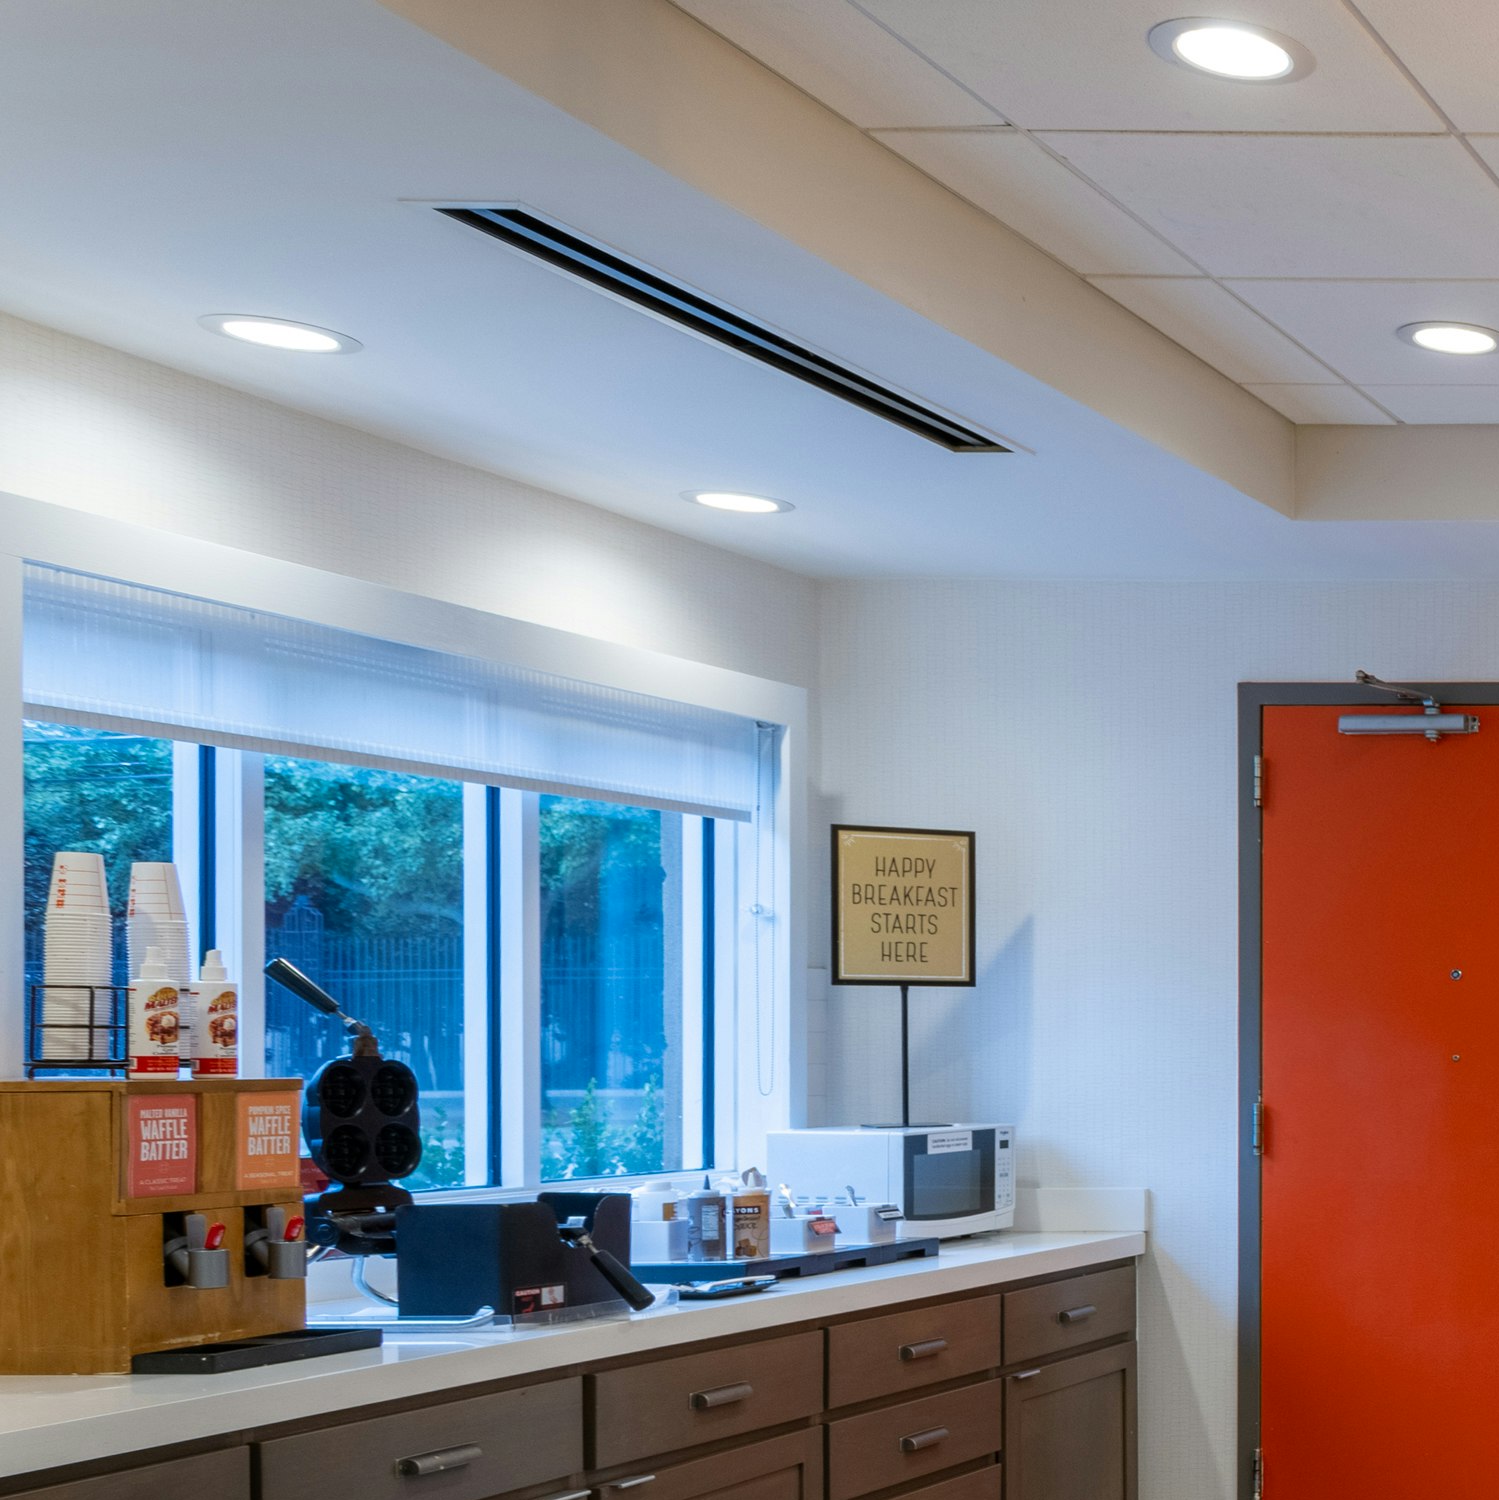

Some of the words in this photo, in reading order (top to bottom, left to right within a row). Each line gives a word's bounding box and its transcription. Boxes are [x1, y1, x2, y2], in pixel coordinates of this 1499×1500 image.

[875, 856, 936, 879] HAPPY
[852, 883, 958, 908] BREAKFAST
[870, 912, 938, 935] STARTS
[881, 941, 928, 963] HERE
[140, 1119, 188, 1140] WAFFLE
[248, 1116, 291, 1136] WAFFLE
[140, 1140, 188, 1161] BATTER
[247, 1136, 291, 1156] BATTER
